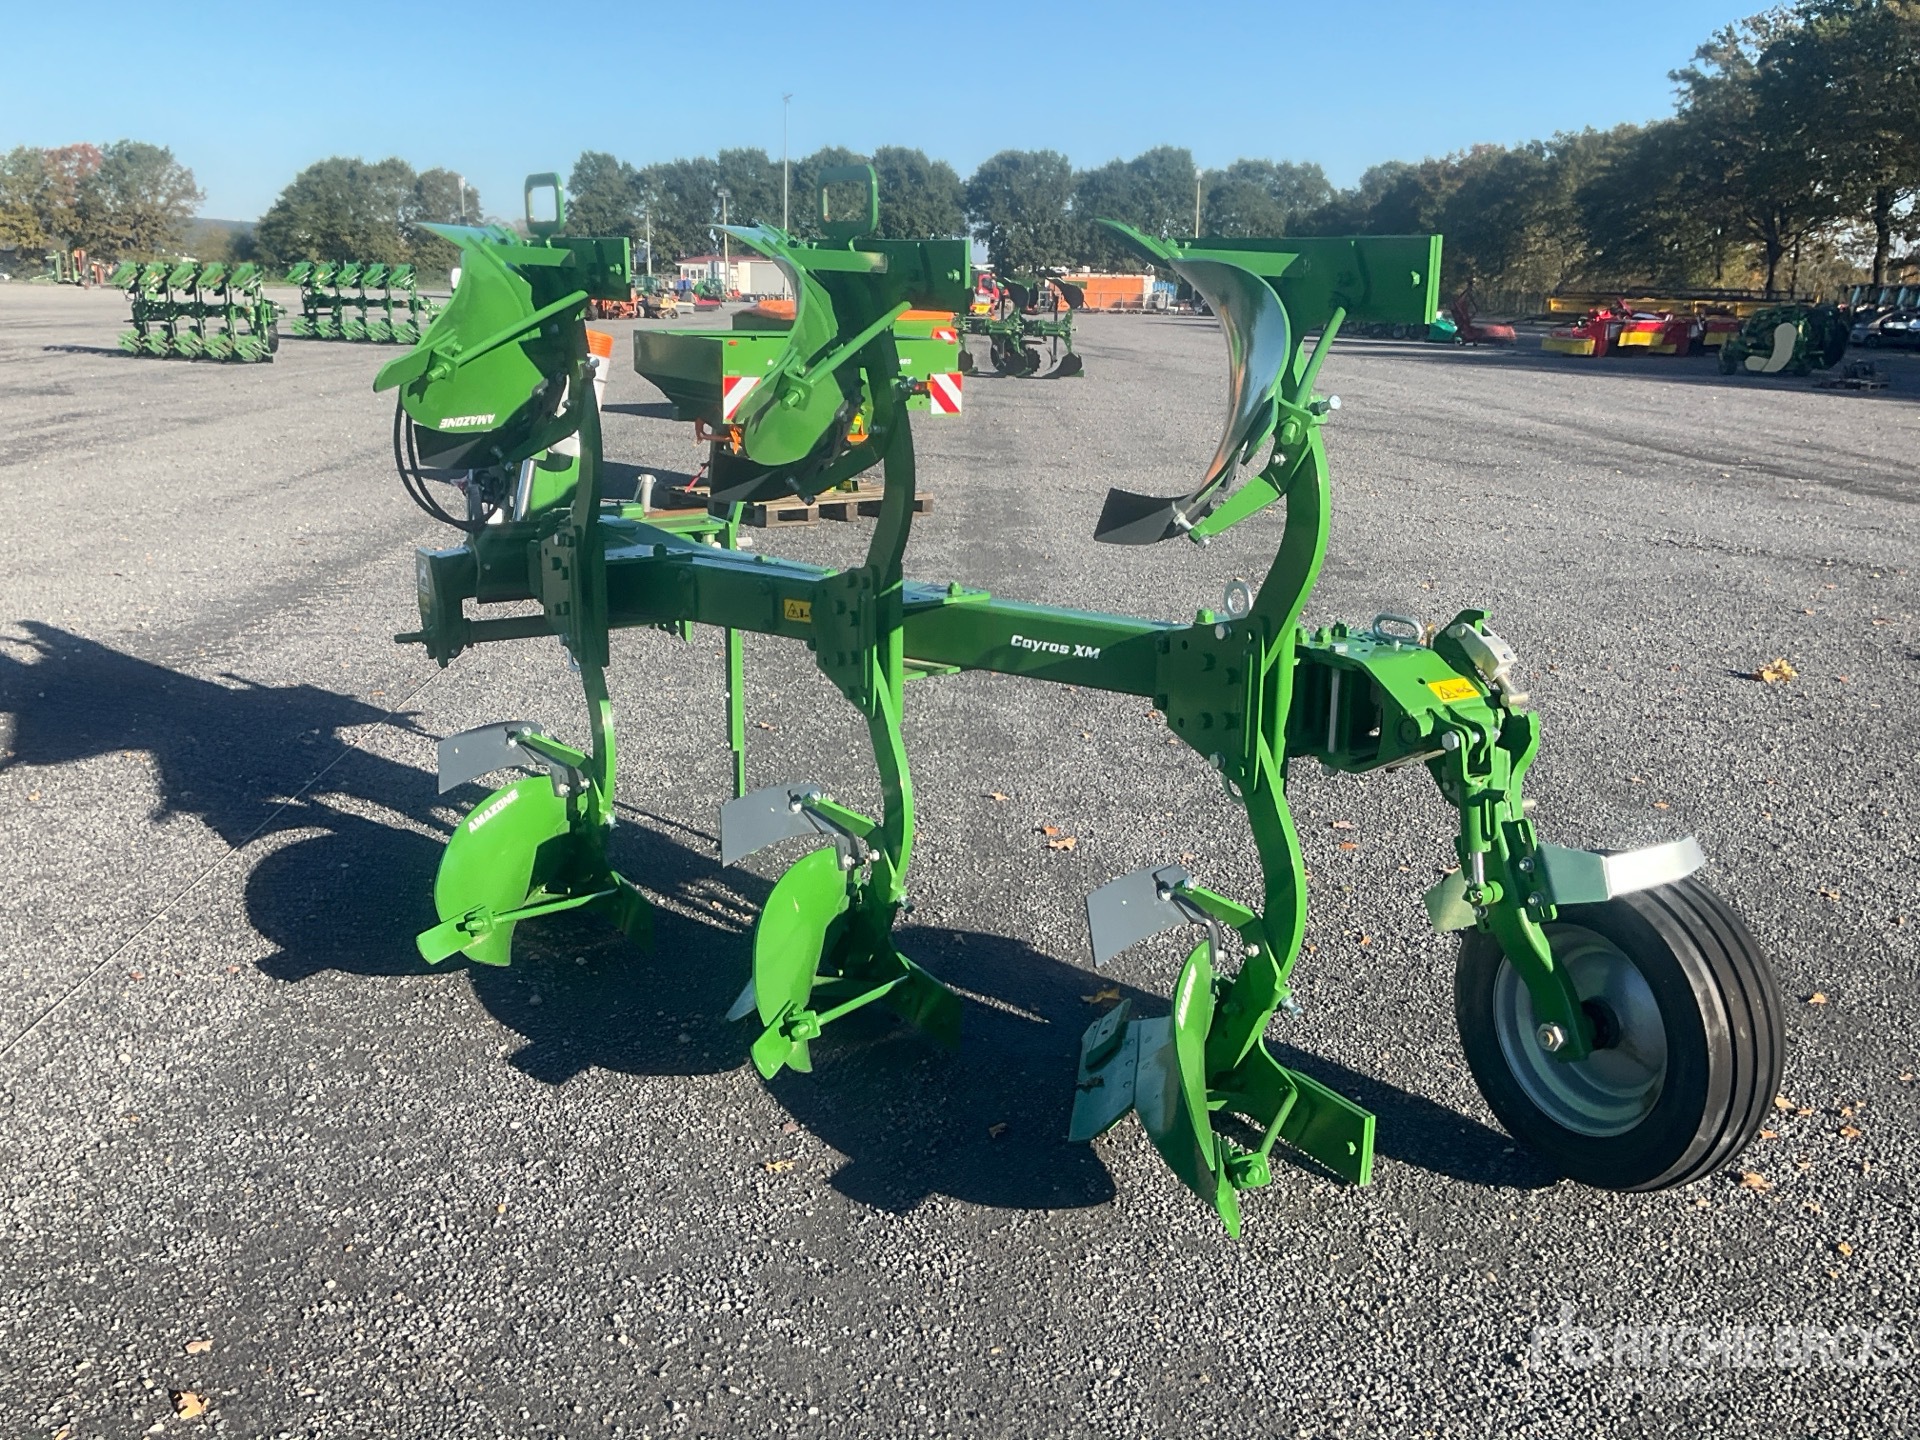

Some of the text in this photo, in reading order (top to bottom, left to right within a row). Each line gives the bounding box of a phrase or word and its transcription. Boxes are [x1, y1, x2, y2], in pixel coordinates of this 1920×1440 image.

[439, 414, 496, 429] AMAZONE
[1010, 634, 1101, 659] Cayros XM
[468, 788, 519, 834] AMAZONE
